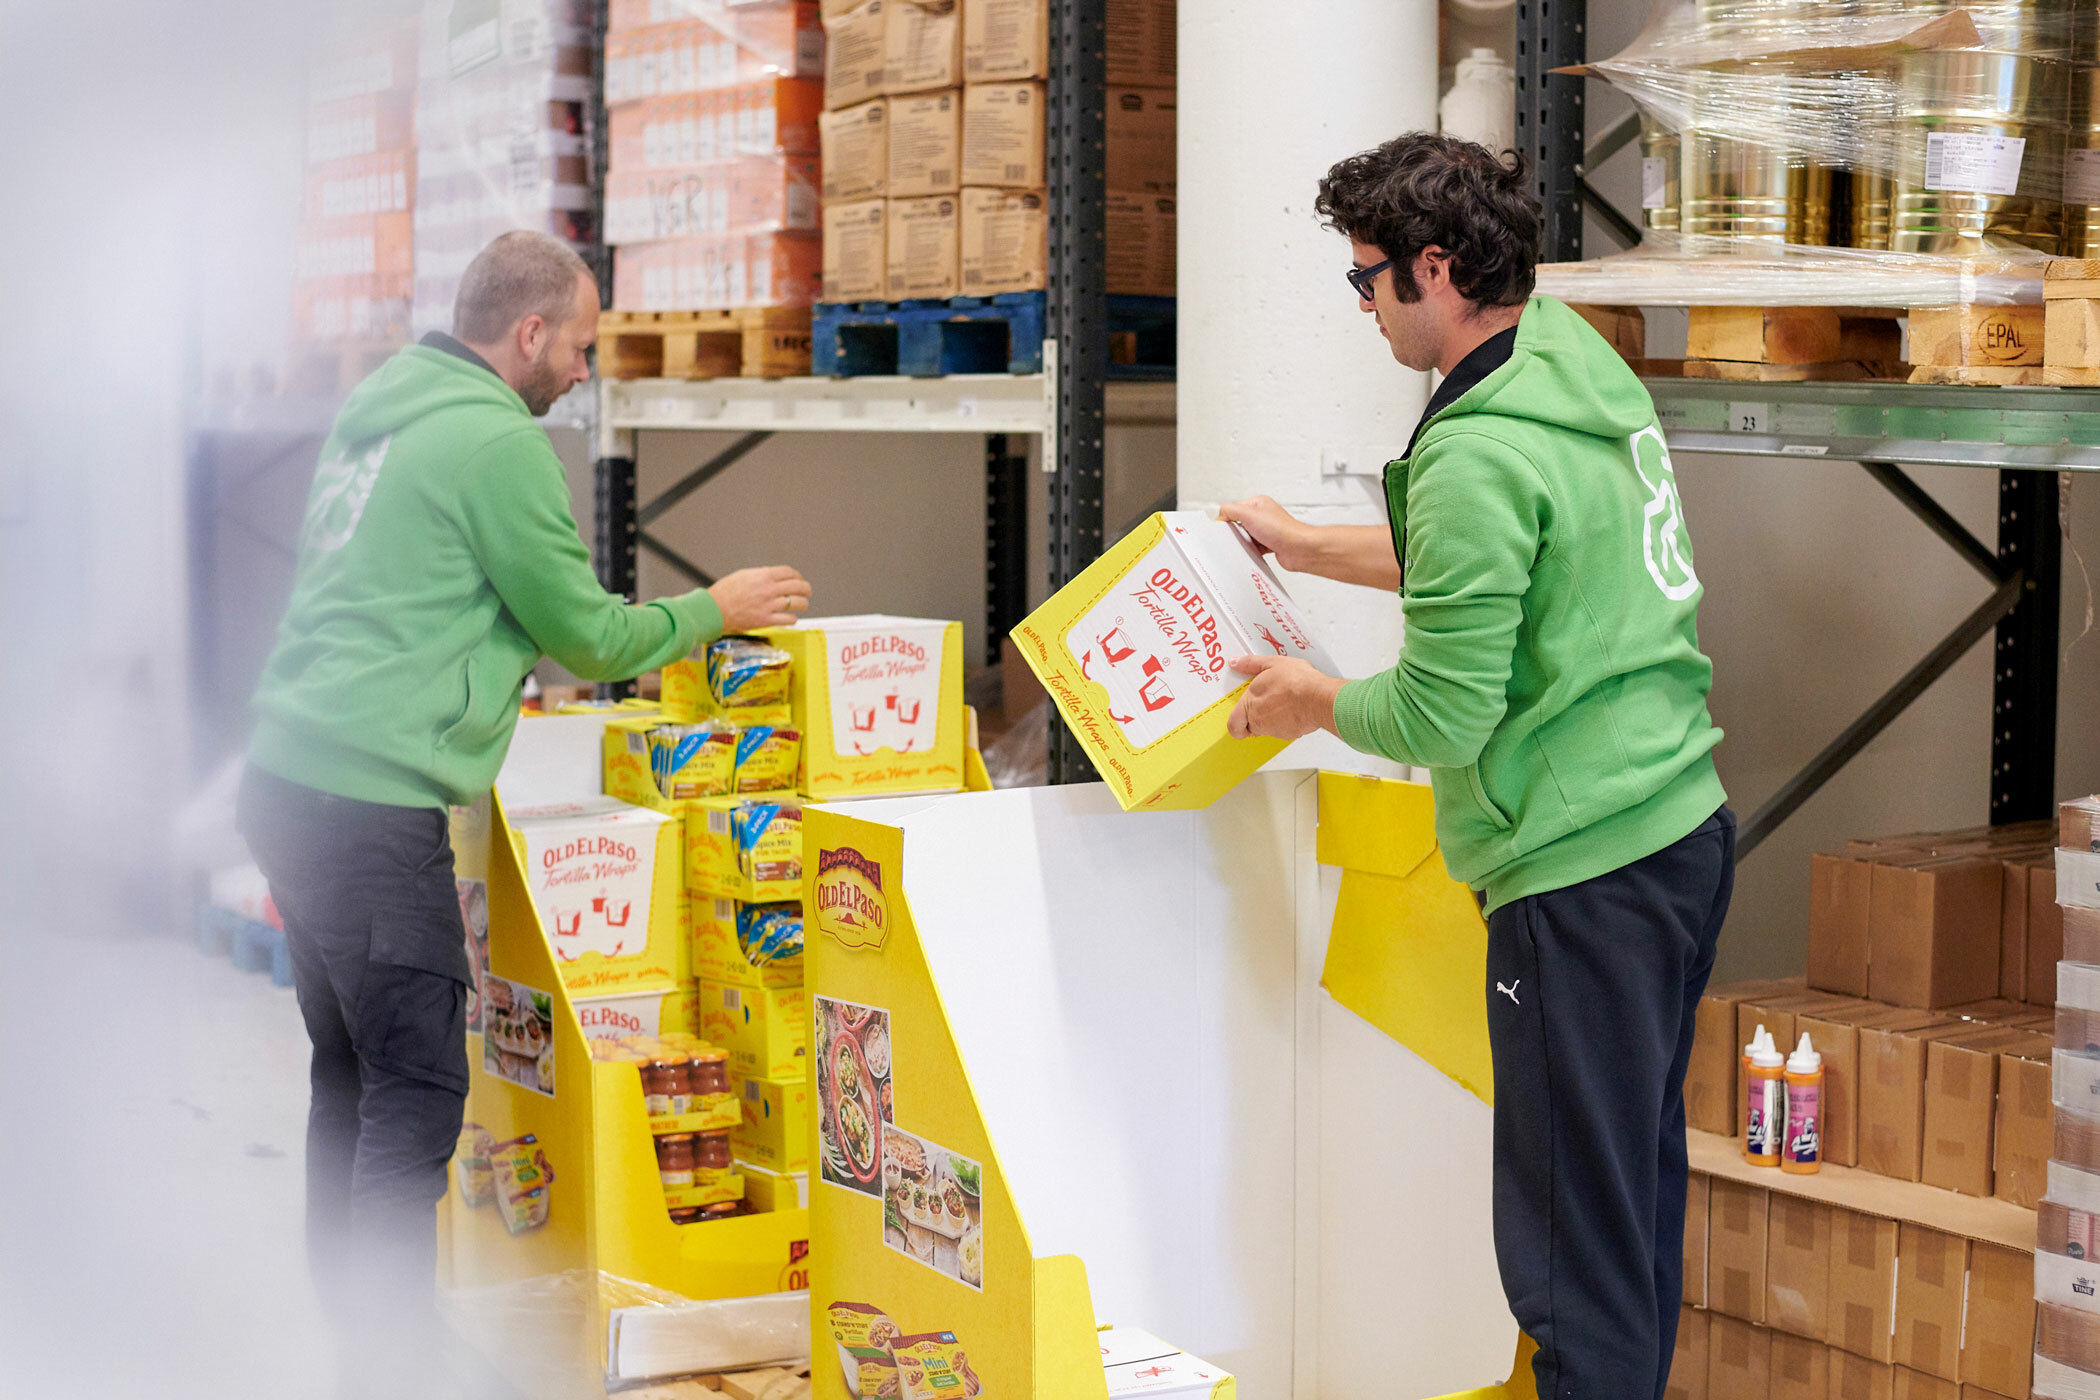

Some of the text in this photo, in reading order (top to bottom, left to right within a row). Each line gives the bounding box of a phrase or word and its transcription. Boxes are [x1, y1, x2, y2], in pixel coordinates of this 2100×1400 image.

[1987, 322, 2025, 348] EPAL
[1741, 415, 1757, 431] 23
[1129, 581, 1213, 683] Tortilla Wraps
[840, 659, 930, 686] Tortilla Wraps
[1045, 669, 1110, 752] Tortilla Wraps
[543, 861, 638, 891] Tortilla Wraps
[2074, 1285, 2094, 1295] TINE
[922, 1356, 949, 1371] Mini
